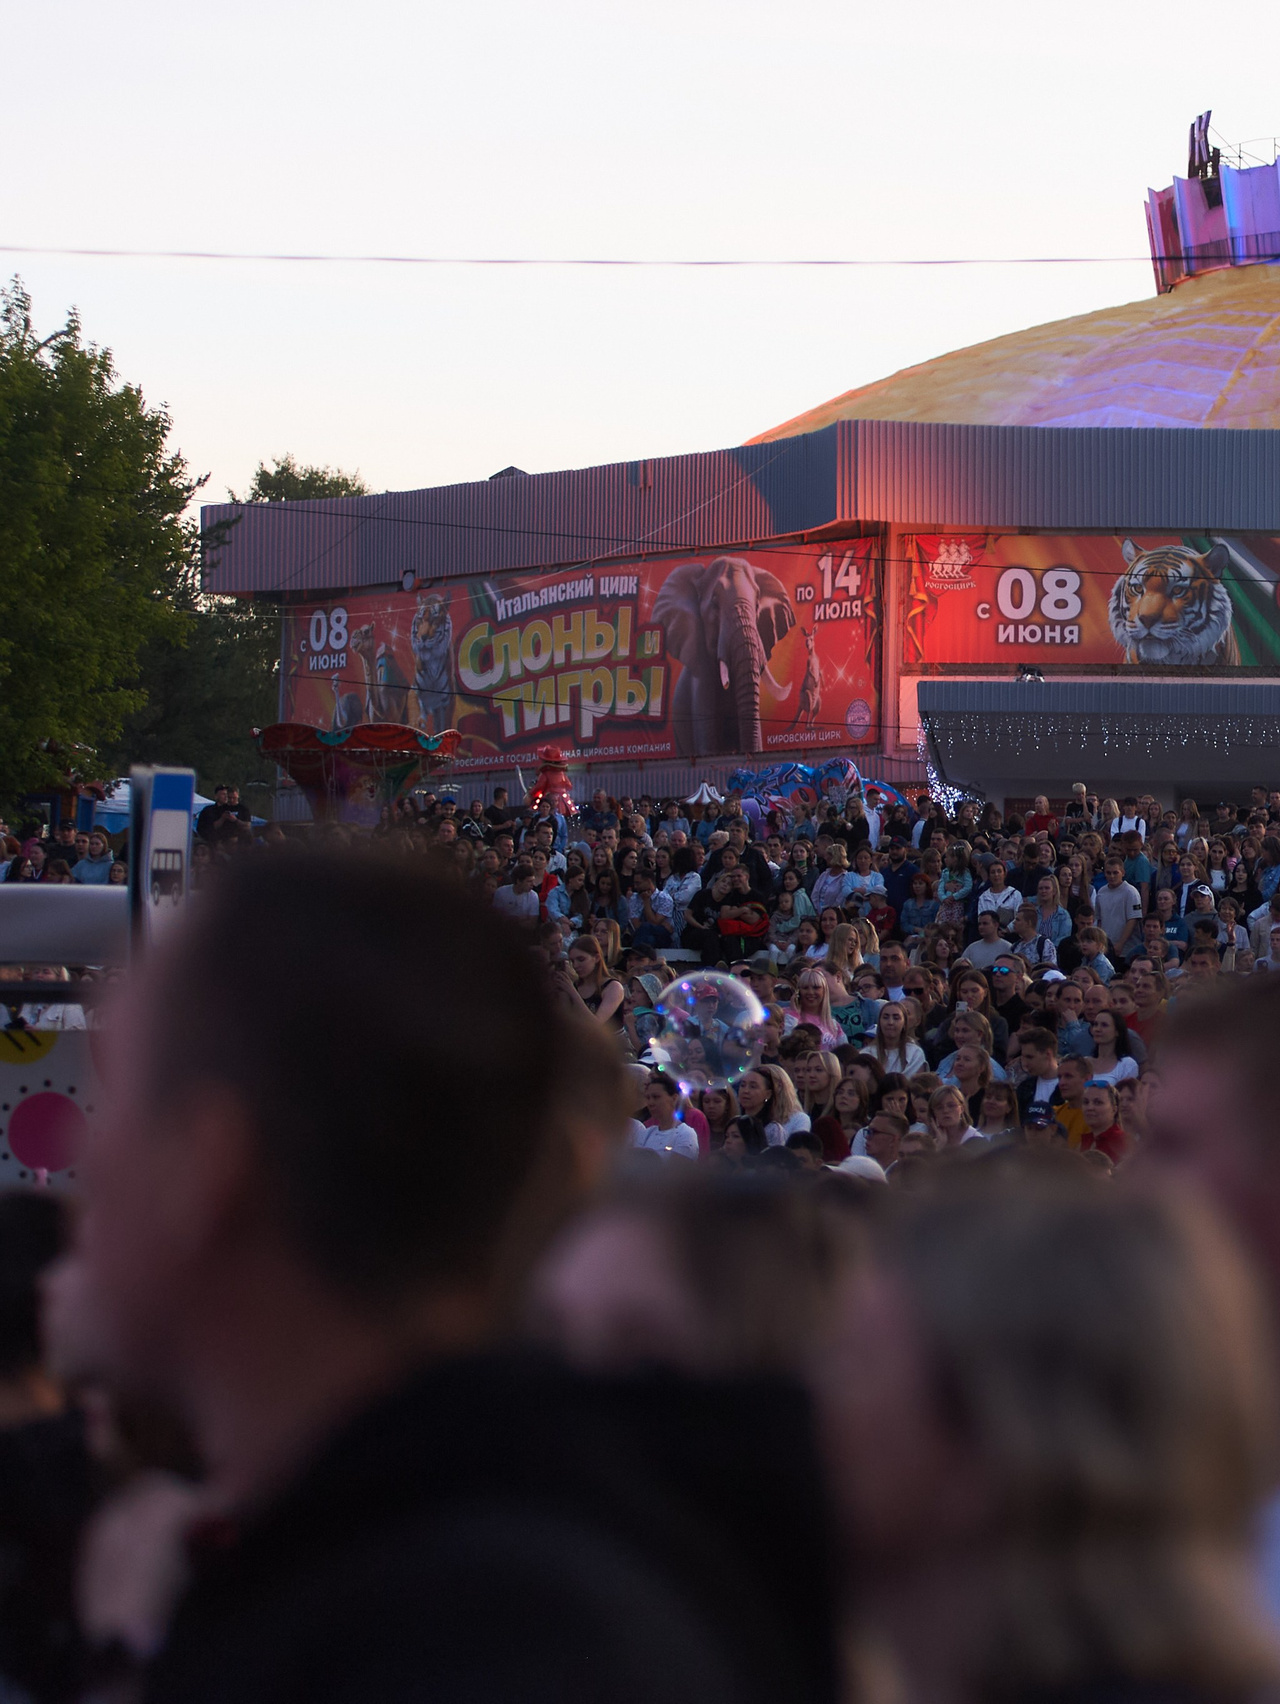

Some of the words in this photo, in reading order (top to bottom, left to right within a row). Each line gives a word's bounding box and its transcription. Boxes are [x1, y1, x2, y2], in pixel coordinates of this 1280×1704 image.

[496, 573, 594, 621] Итальянский
[599, 575, 638, 597] цирк
[818, 550, 861, 599] 14
[997, 567, 1082, 620] 08
[310, 606, 348, 652] 08
[455, 754, 504, 767] РОССИЙСКАЯ
[583, 746, 625, 758] ЦИРКОВАЯ
[627, 743, 671, 754] КОМПАНИЯ
[766, 730, 816, 744] КИРОВСКИЙ
[818, 731, 841, 742] ЦИРК
